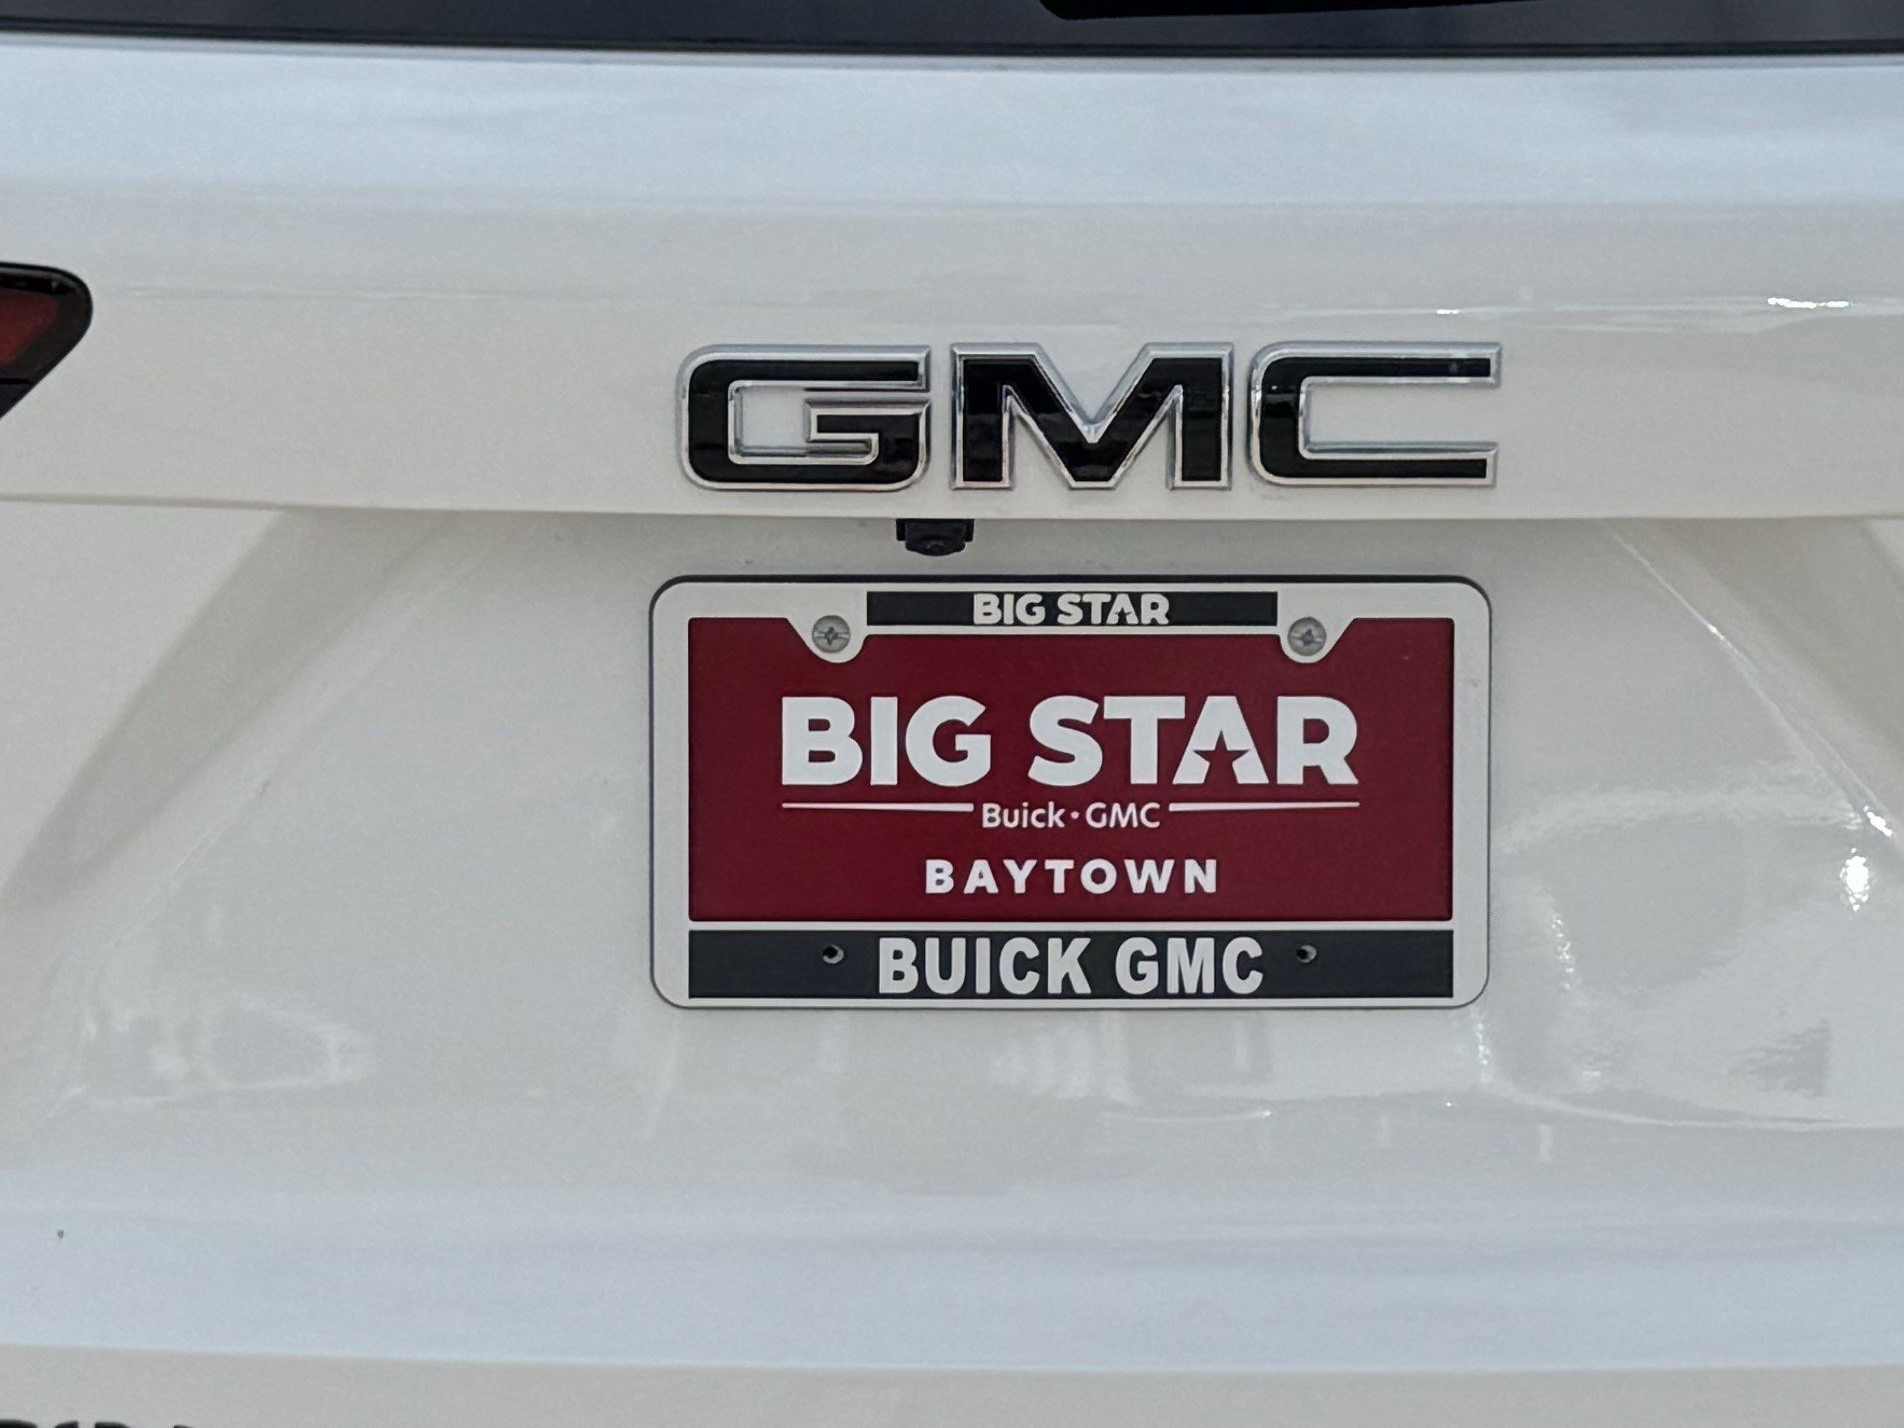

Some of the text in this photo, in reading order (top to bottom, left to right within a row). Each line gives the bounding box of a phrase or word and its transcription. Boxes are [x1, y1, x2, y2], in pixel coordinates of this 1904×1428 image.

[676, 342, 1502, 491] GMC
[973, 593, 1170, 625] BIG STAR
[781, 695, 1359, 787] BIG STAR
[982, 801, 1161, 829] Buick GMC
[925, 858, 1218, 895] BAYTOWN
[878, 936, 1264, 996] BUICK GMC
